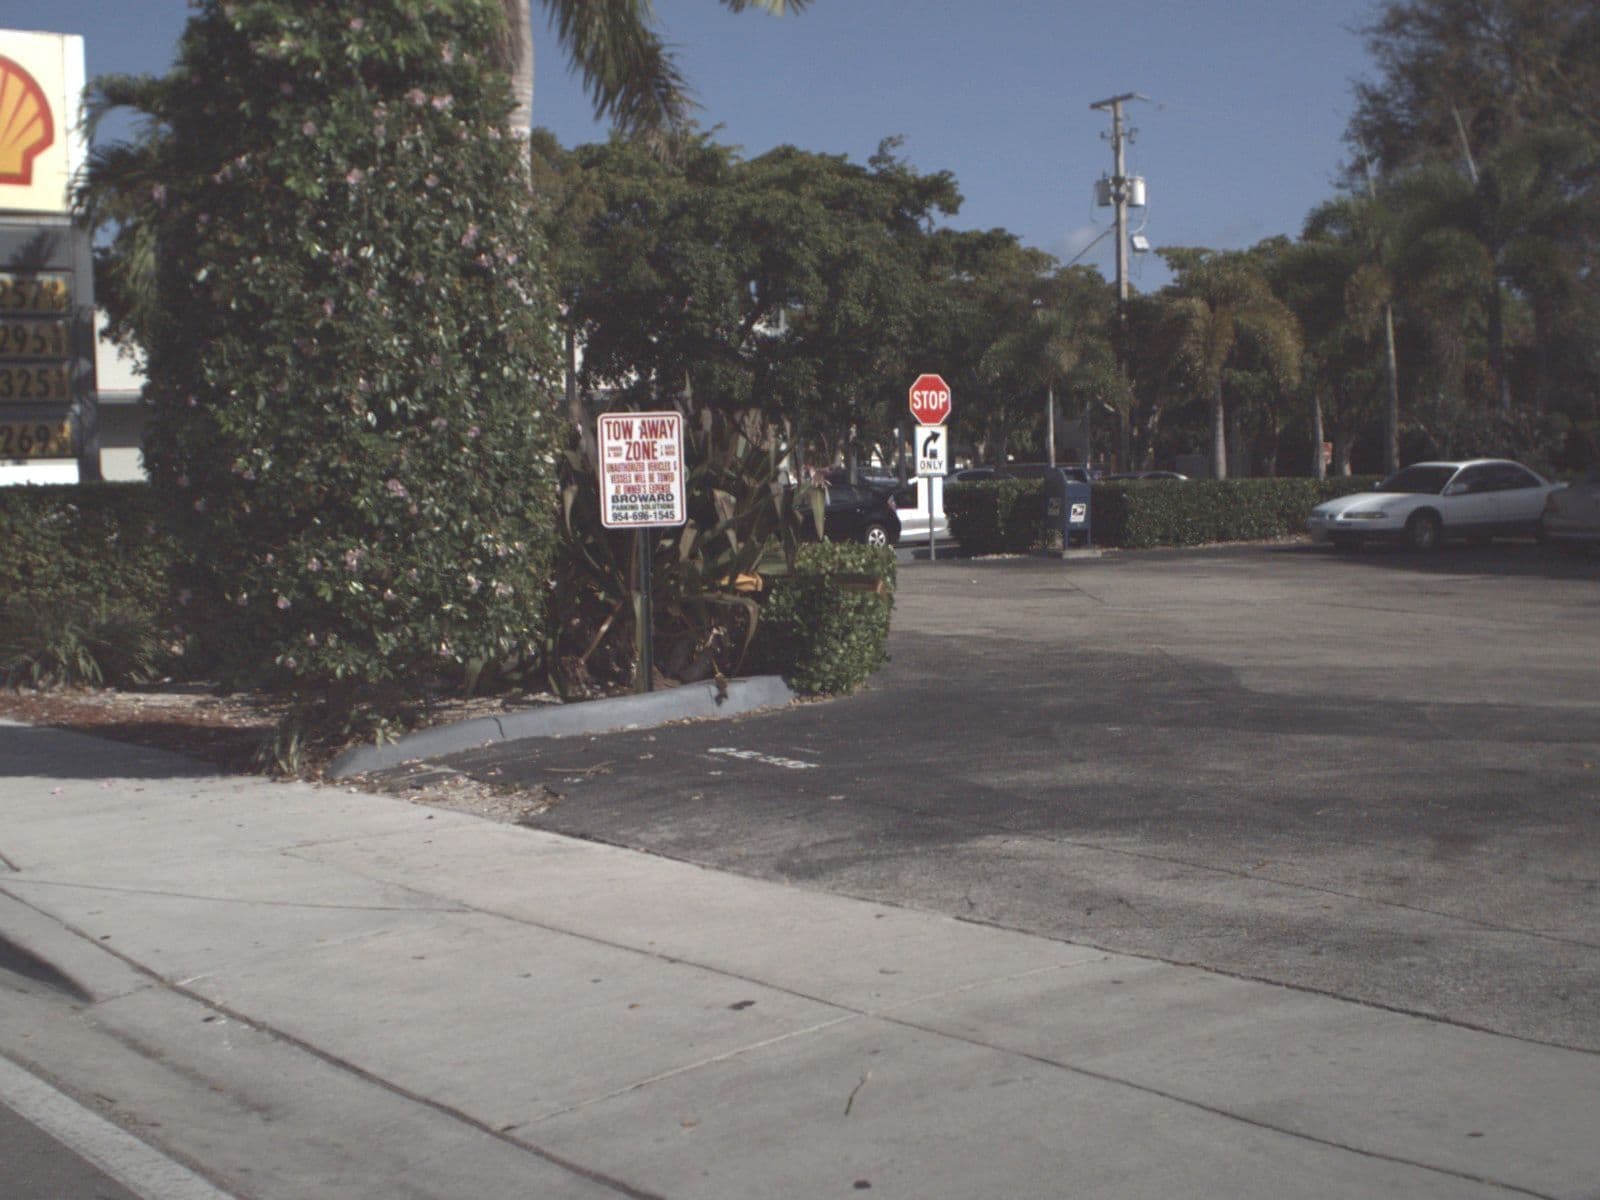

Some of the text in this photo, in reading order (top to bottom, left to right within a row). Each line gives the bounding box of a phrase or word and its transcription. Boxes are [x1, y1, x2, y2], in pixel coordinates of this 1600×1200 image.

[912, 390, 948, 410] STOP
[605, 419, 675, 440] TOW AWAY
[625, 441, 658, 461] ZONE
[919, 460, 943, 470] ONLY
[611, 493, 674, 503] BROWARD
[611, 502, 674, 511] PARKING SOLUTIONS
